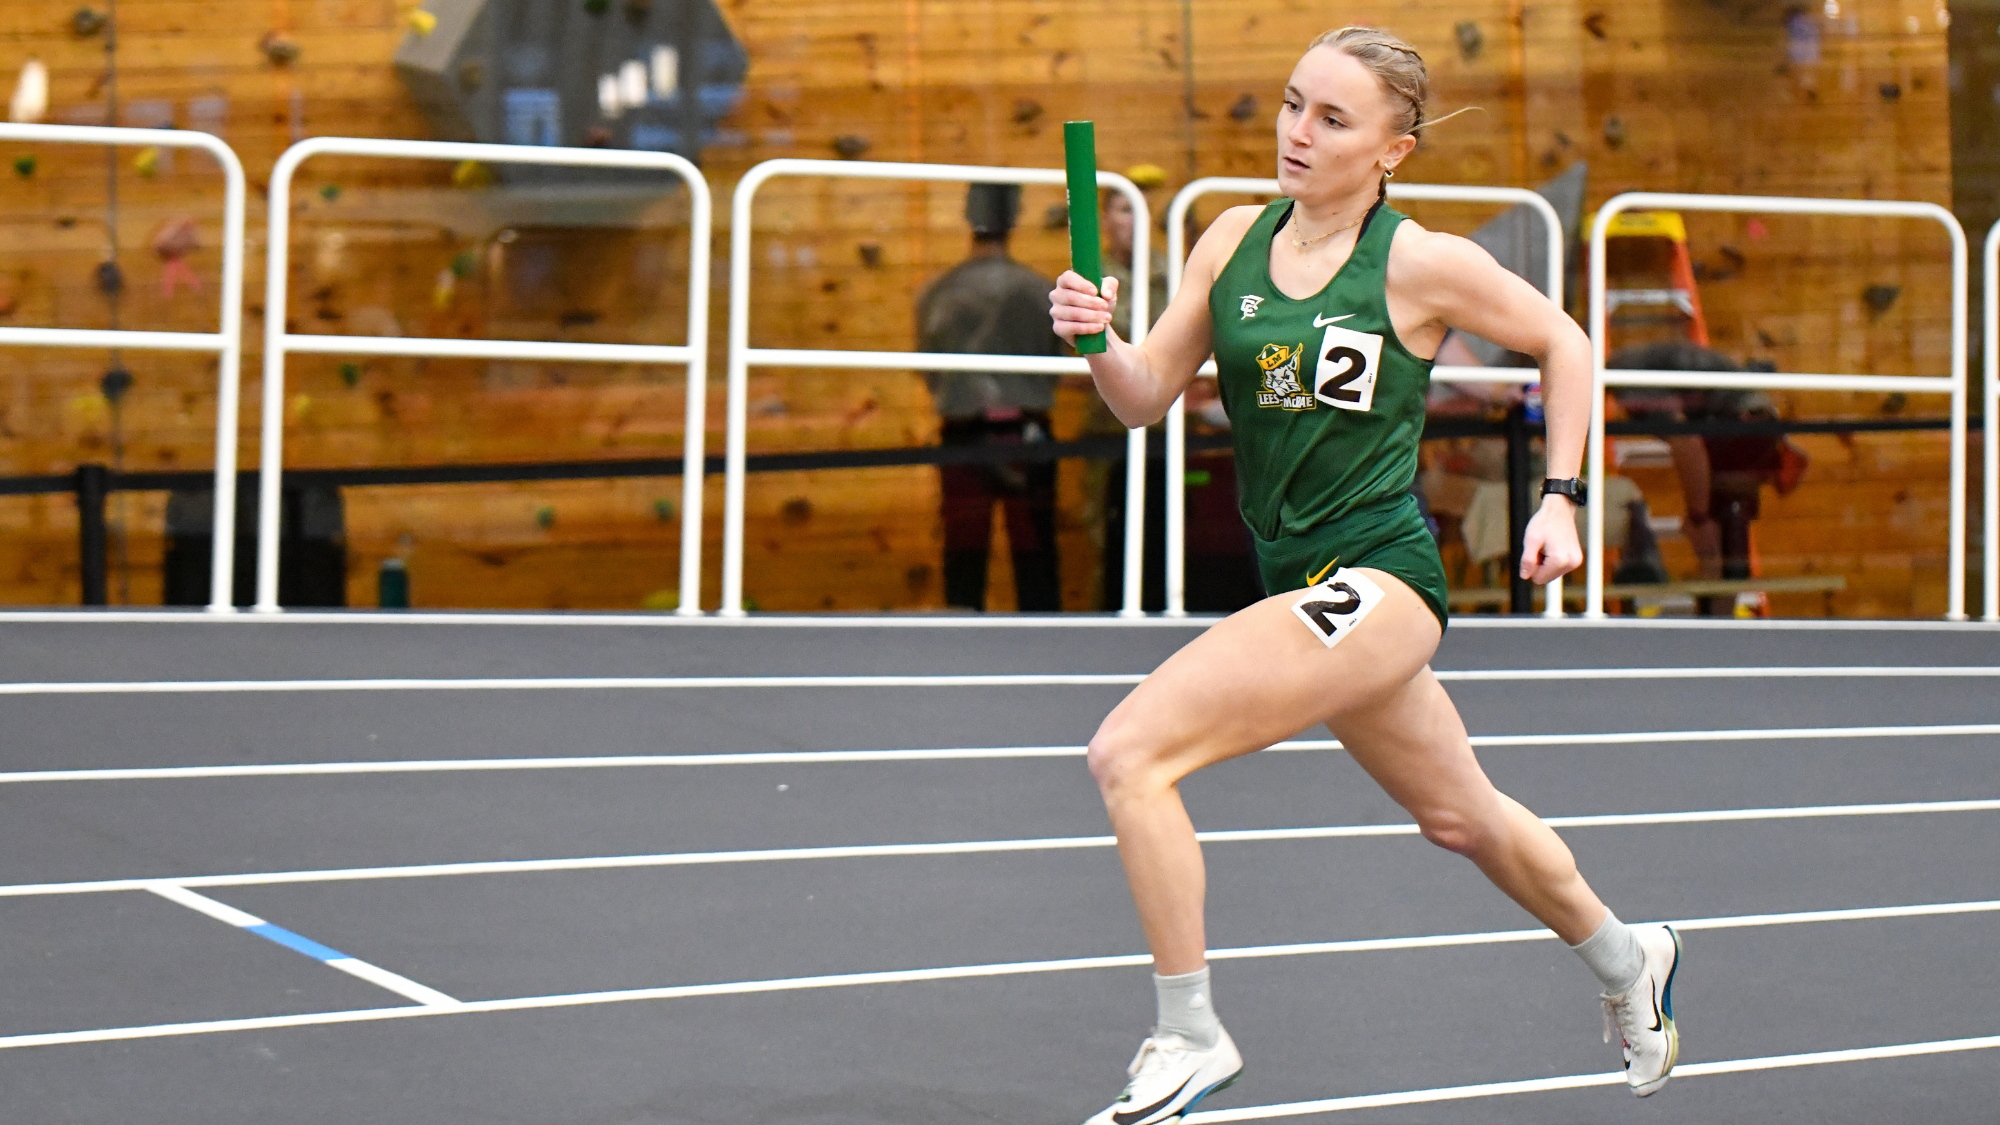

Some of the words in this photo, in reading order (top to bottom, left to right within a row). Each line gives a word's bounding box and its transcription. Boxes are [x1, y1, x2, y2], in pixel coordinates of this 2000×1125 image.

[1266, 353, 1283, 368] LM
[1318, 345, 1367, 404] 2
[1300, 581, 1361, 637] 2
